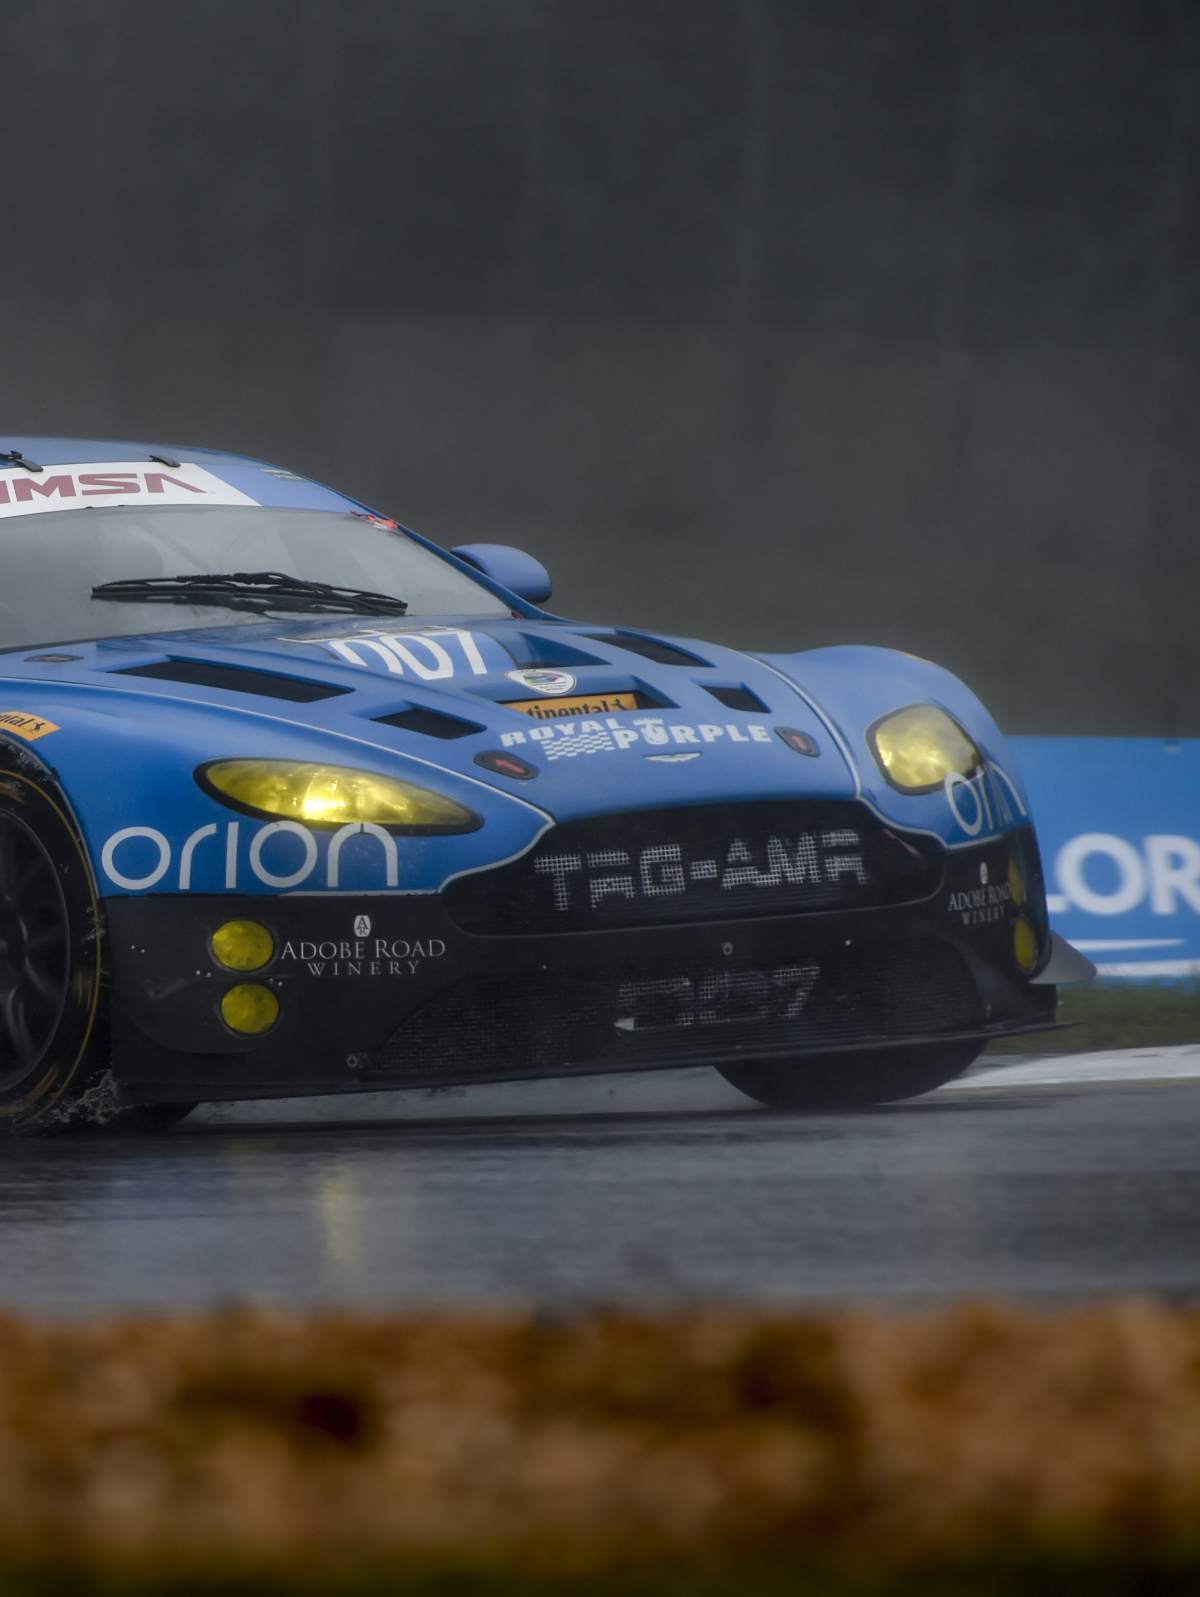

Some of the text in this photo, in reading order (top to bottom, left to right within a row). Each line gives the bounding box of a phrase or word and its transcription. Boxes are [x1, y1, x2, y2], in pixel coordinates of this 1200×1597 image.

[501, 717, 625, 748] ROYAL
[614, 719, 774, 750] PURPLE
[101, 820, 399, 890] orion
[534, 829, 869, 911] TRG-AMR
[948, 888, 987, 912] ADOBE
[280, 938, 446, 960] ADOBE ROAD
[306, 960, 421, 977] WINERY
